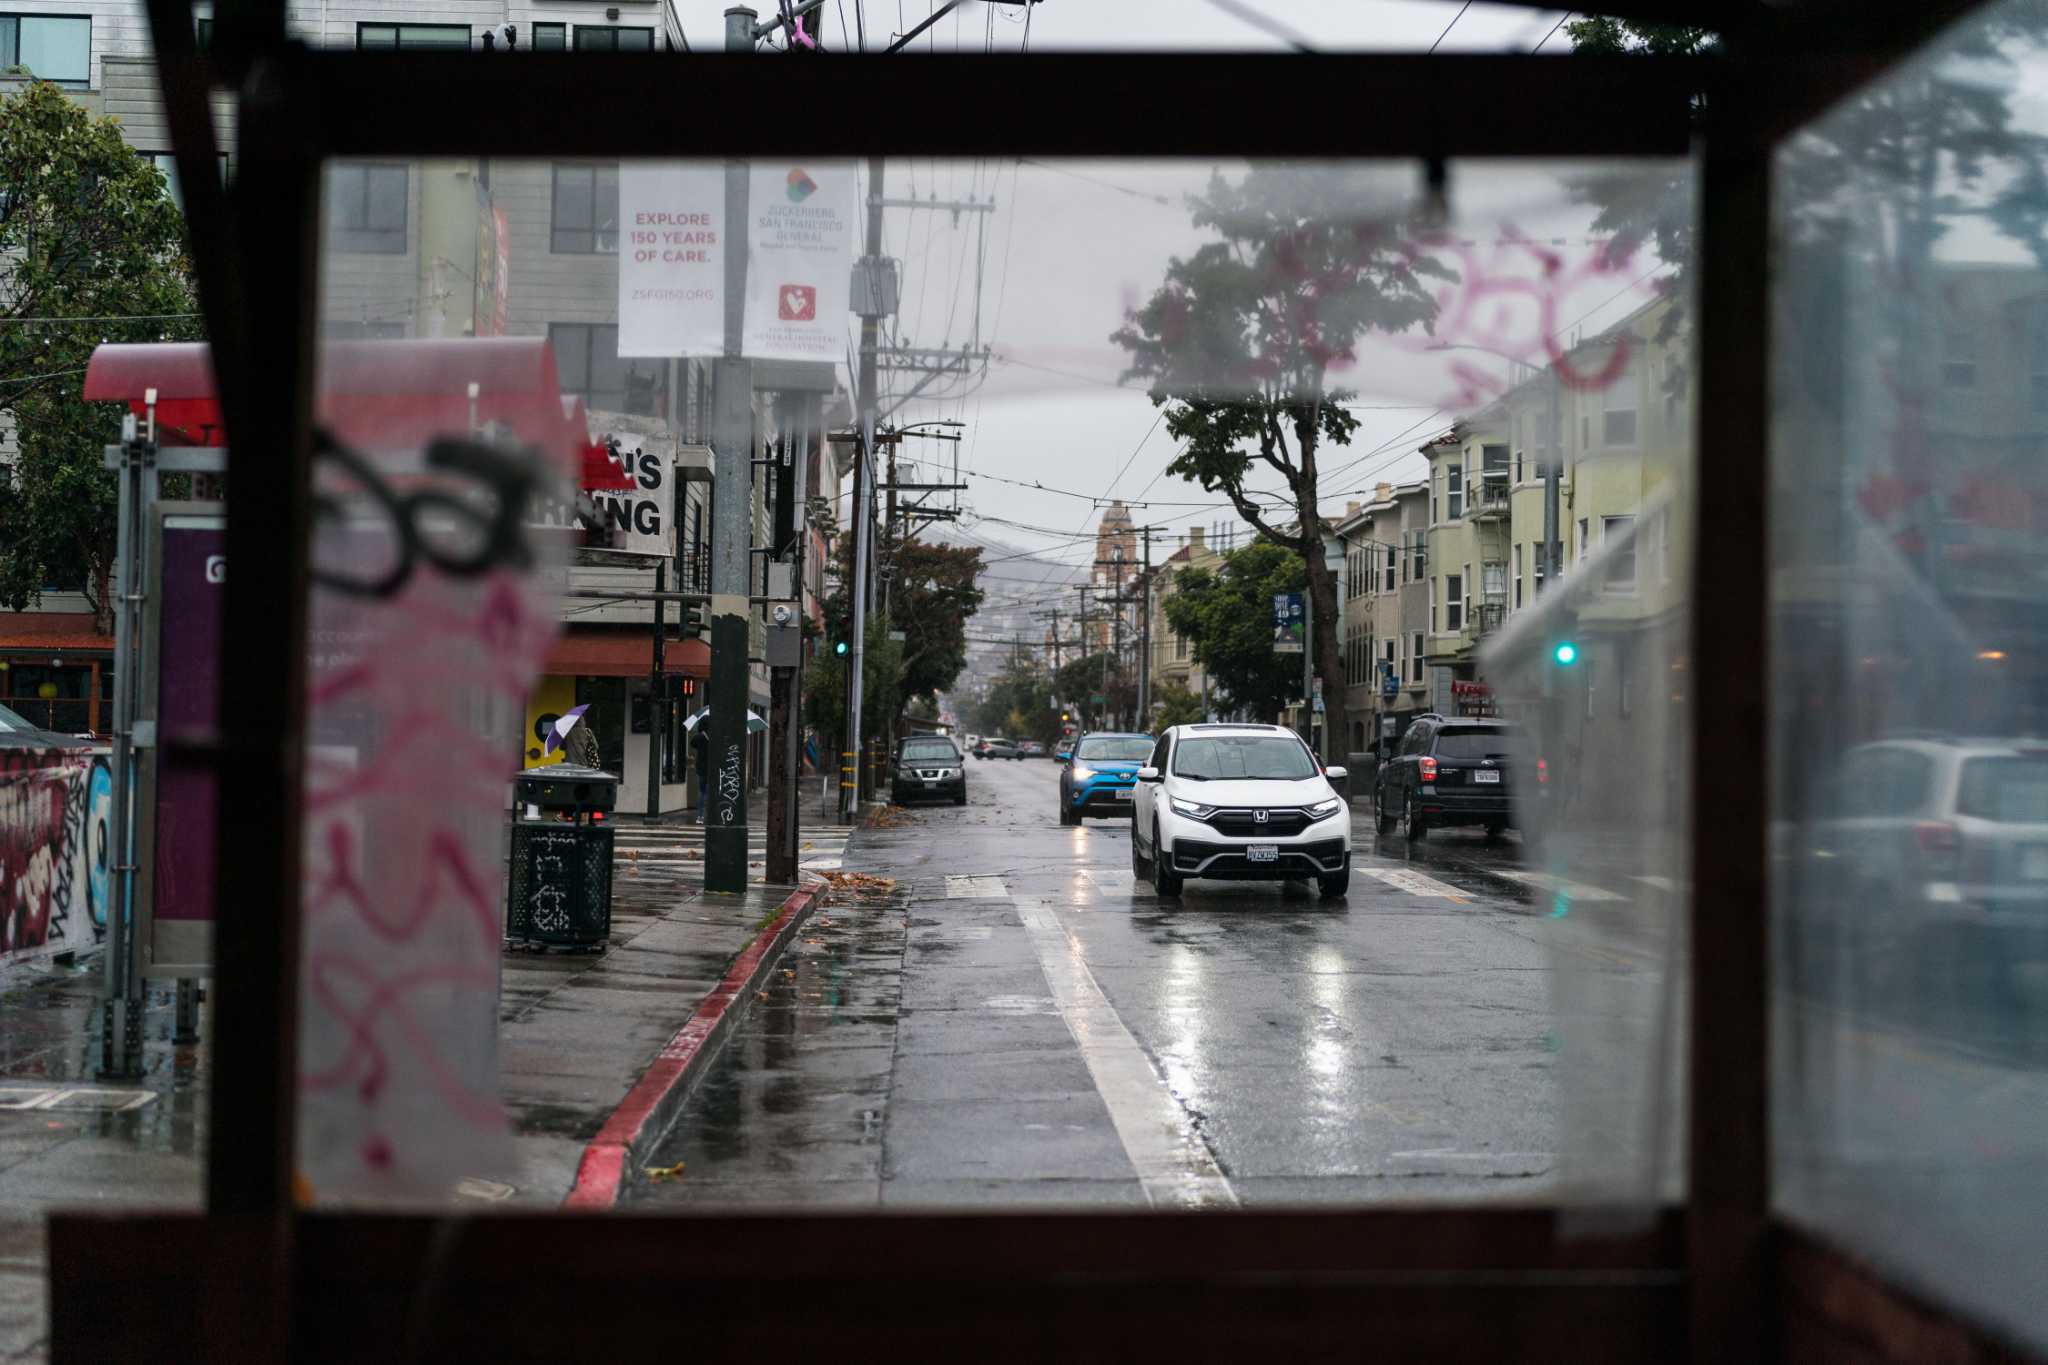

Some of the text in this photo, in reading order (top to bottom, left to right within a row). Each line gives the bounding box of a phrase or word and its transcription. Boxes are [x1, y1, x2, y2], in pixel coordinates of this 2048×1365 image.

[635, 212, 711, 226] EXPLORE
[630, 231, 717, 245] 150 YEARS
[634, 249, 711, 263] OF CARE.
